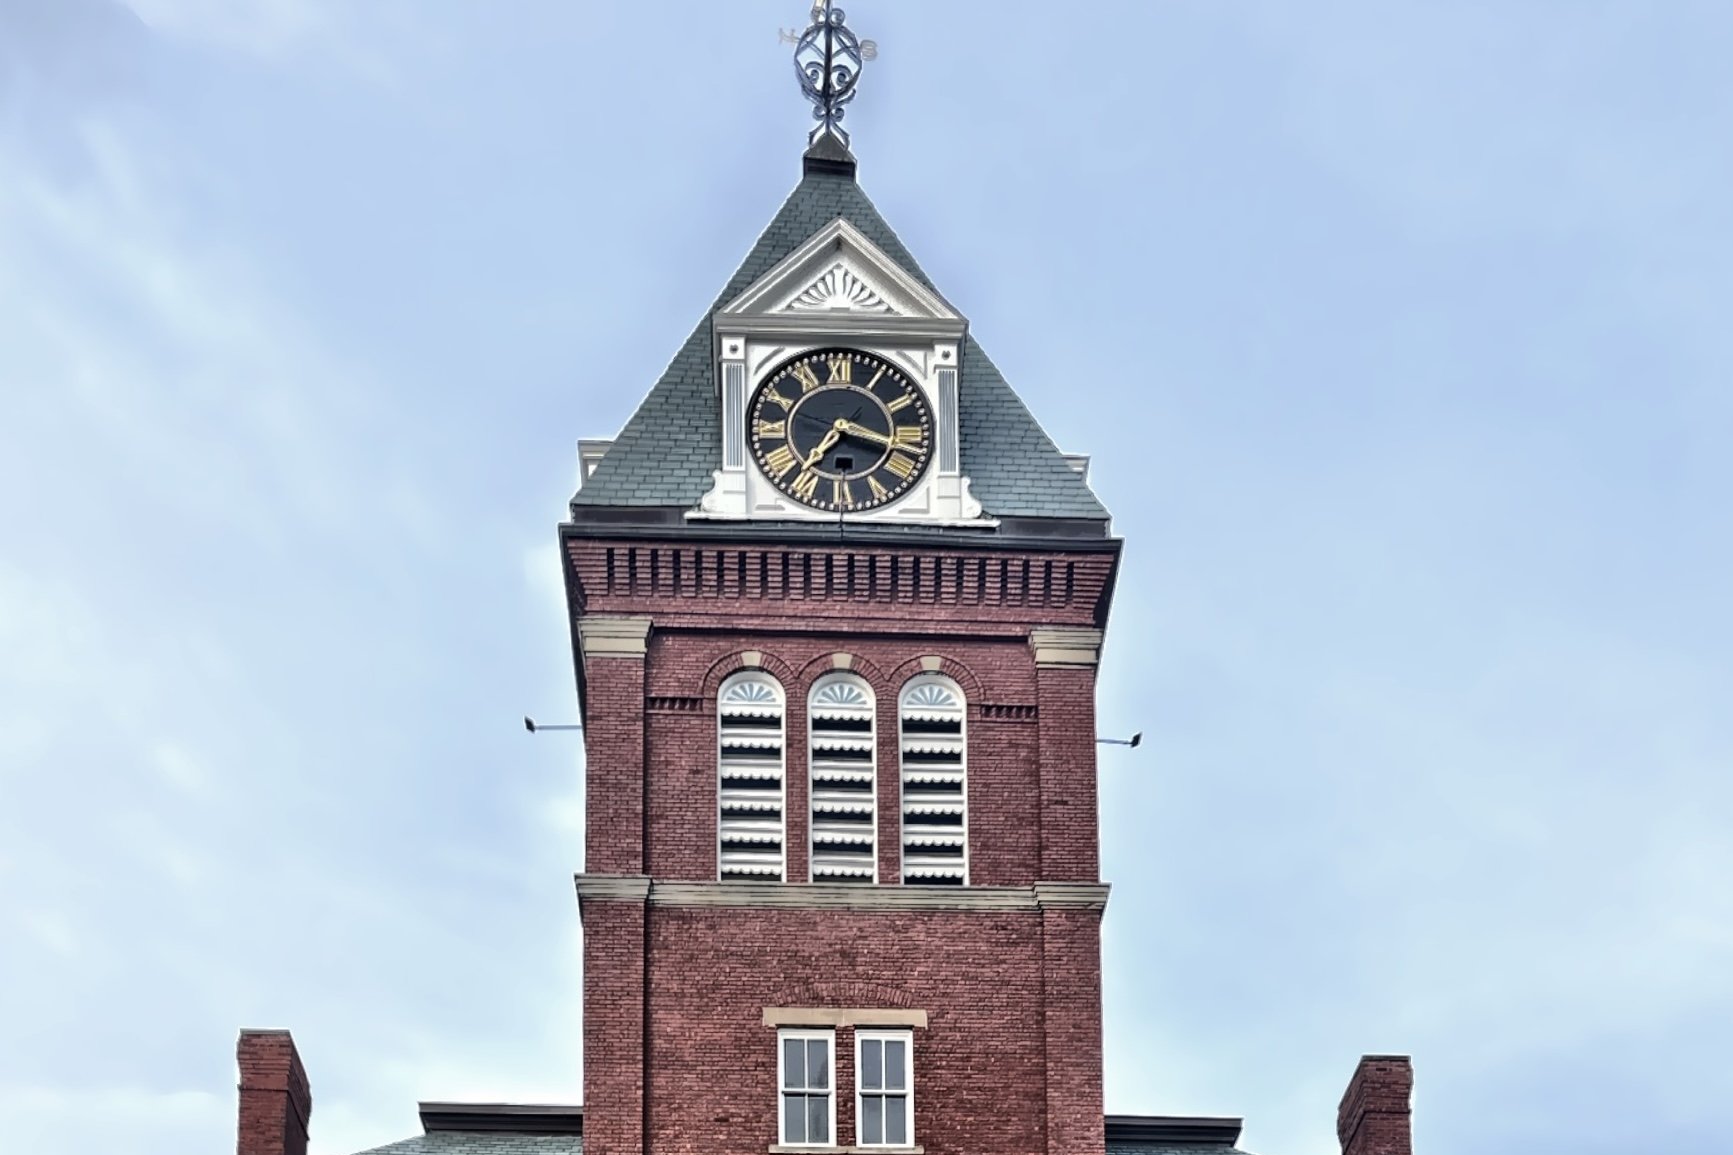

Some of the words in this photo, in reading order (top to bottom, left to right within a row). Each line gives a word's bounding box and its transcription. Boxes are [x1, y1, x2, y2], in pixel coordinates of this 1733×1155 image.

[791, 363, 820, 392] XI
[827, 358, 852, 385] XII
[767, 388, 794, 411] X
[888, 393, 914, 414] II
[759, 420, 785, 440] IX
[868, 476, 889, 499] V
